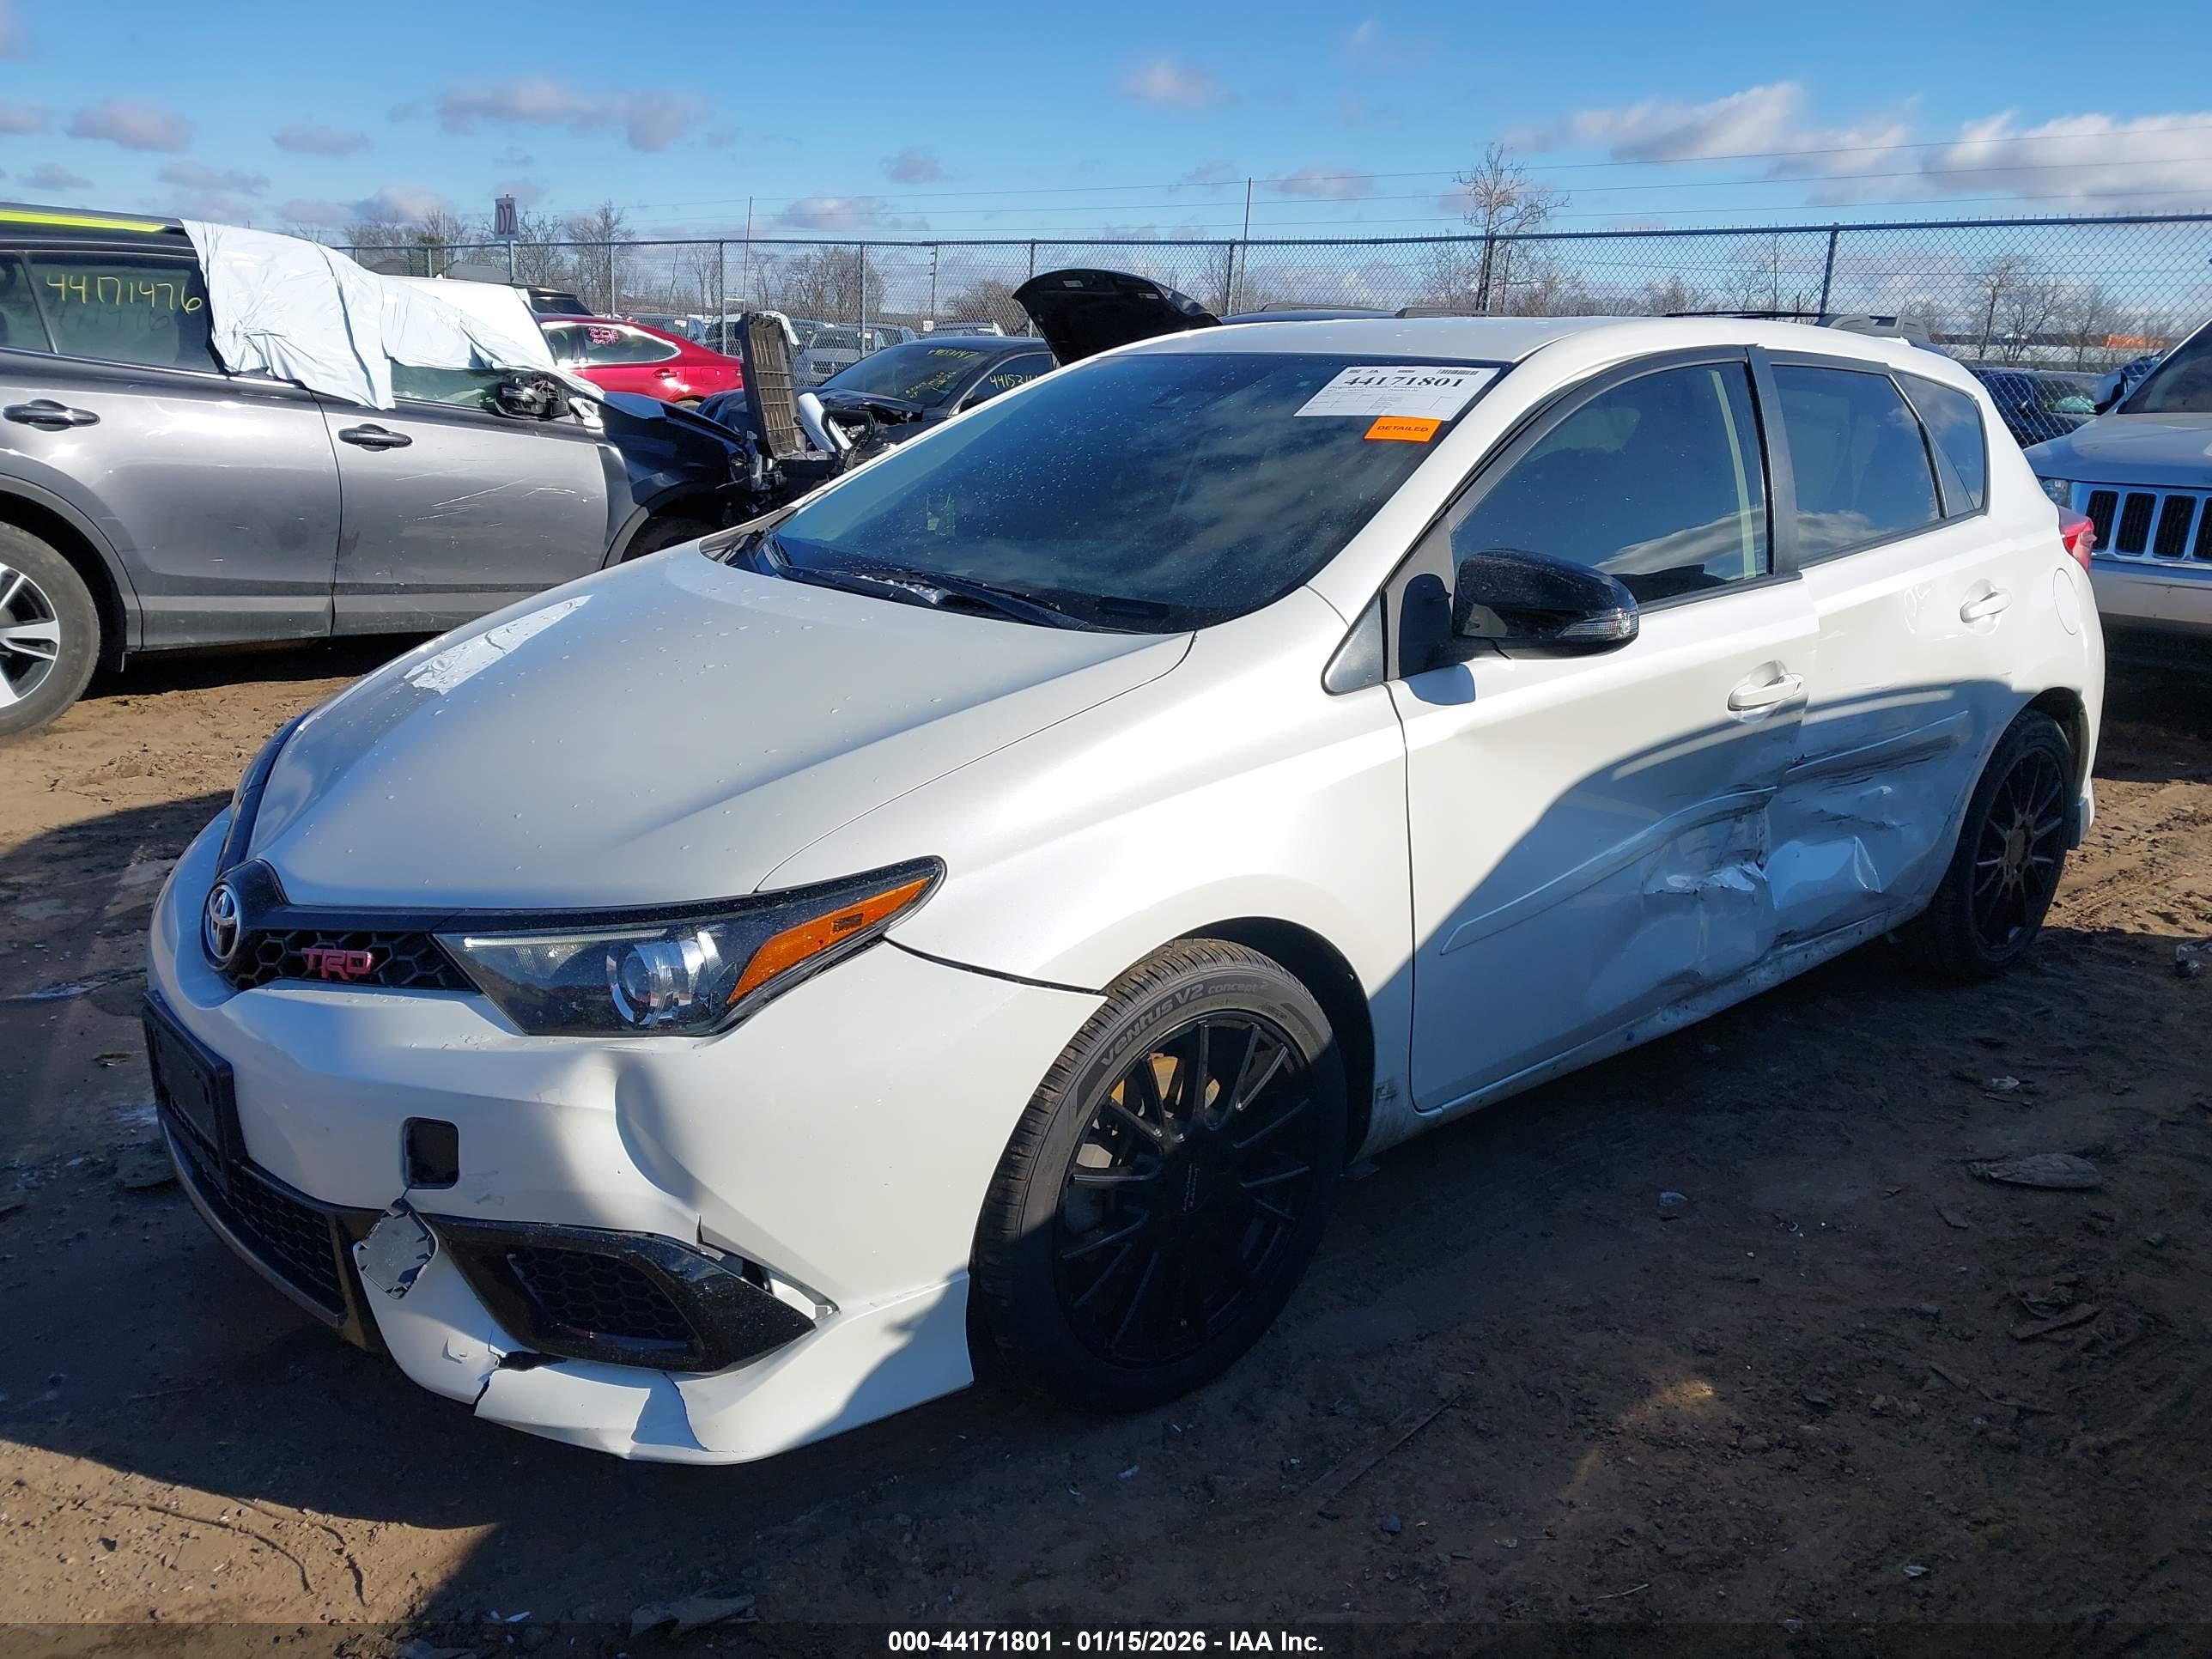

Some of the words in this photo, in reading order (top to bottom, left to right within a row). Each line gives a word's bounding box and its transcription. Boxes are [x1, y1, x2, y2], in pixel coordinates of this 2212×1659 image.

[46, 272, 203, 316] 44171476
[1344, 376, 1465, 387] 44171801
[301, 947, 374, 981] TRD
[1175, 984, 1204, 1005] V2
[1207, 982, 1258, 994] concept
